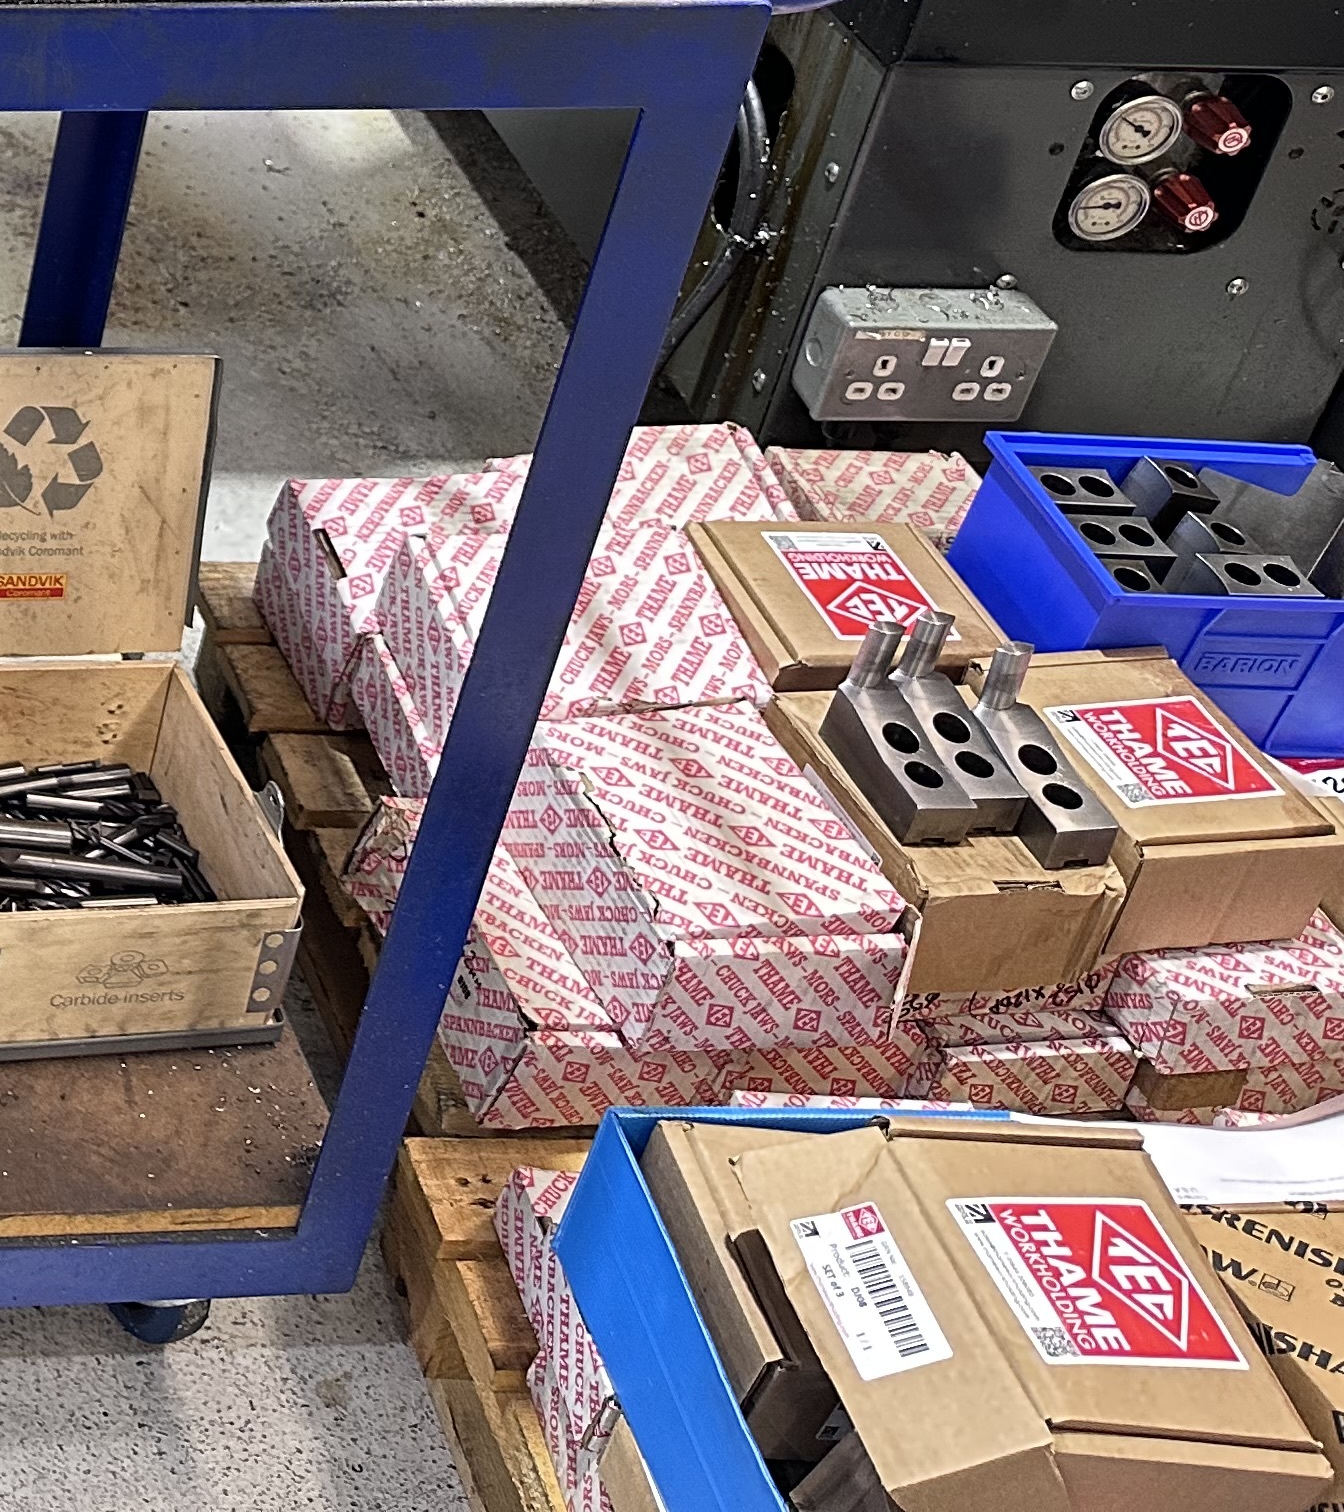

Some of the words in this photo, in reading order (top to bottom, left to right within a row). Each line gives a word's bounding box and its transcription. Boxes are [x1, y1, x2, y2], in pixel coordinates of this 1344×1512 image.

[656, 474, 697, 519] THAME
[28, 546, 84, 558] Coromant
[46, 529, 74, 541] with
[787, 553, 893, 564] WORKHOLDING
[796, 563, 906, 581] THAME
[608, 574, 639, 611] MORS
[636, 574, 678, 623] THAME
[560, 640, 595, 686] CHUCK
[588, 612, 614, 648] JAWS
[641, 636, 674, 675] MORS
[671, 635, 713, 686] THAME
[1194, 656, 1299, 674] BARION
[588, 646, 632, 697] THAME
[545, 727, 606, 757] MORS
[582, 721, 664, 762] THAME
[630, 720, 701, 755] CHUCK
[672, 718, 756, 759] THAME
[1082, 711, 1163, 797] WORKHOLDING
[1100, 709, 1193, 797] THAME
[621, 756, 673, 787] JAWS
[594, 786, 667, 825] CHUCK
[639, 784, 724, 829] THAME
[671, 781, 746, 815] CHUCK
[717, 774, 803, 822] THAME
[540, 871, 584, 891] THAME
[636, 849, 713, 890] CHUCK
[685, 846, 772, 896] THAME
[780, 842, 869, 893] THAME
[568, 901, 596, 923] JAWS
[597, 906, 639, 924] CHUCK
[580, 935, 628, 957] THAME
[502, 967, 575, 1012] CHUCK
[753, 958, 803, 1012] THAME
[804, 969, 841, 1007] MORS
[833, 956, 882, 1009] THAME
[1185, 960, 1244, 988] JAWS
[1264, 955, 1321, 983] JAWS
[715, 964, 757, 1015] CHUCK
[745, 1002, 780, 1036] JAWS
[532, 1069, 566, 1100] JAWS
[607, 1068, 641, 1098] JAWS
[553, 1092, 585, 1125] CHUCK
[997, 1209, 1097, 1350] WORKHOLDING
[1020, 1209, 1132, 1352] THAME
[559, 1294, 571, 1390] THAME
[575, 1321, 586, 1407] CHUCK
[550, 1385, 561, 1456] MORS
